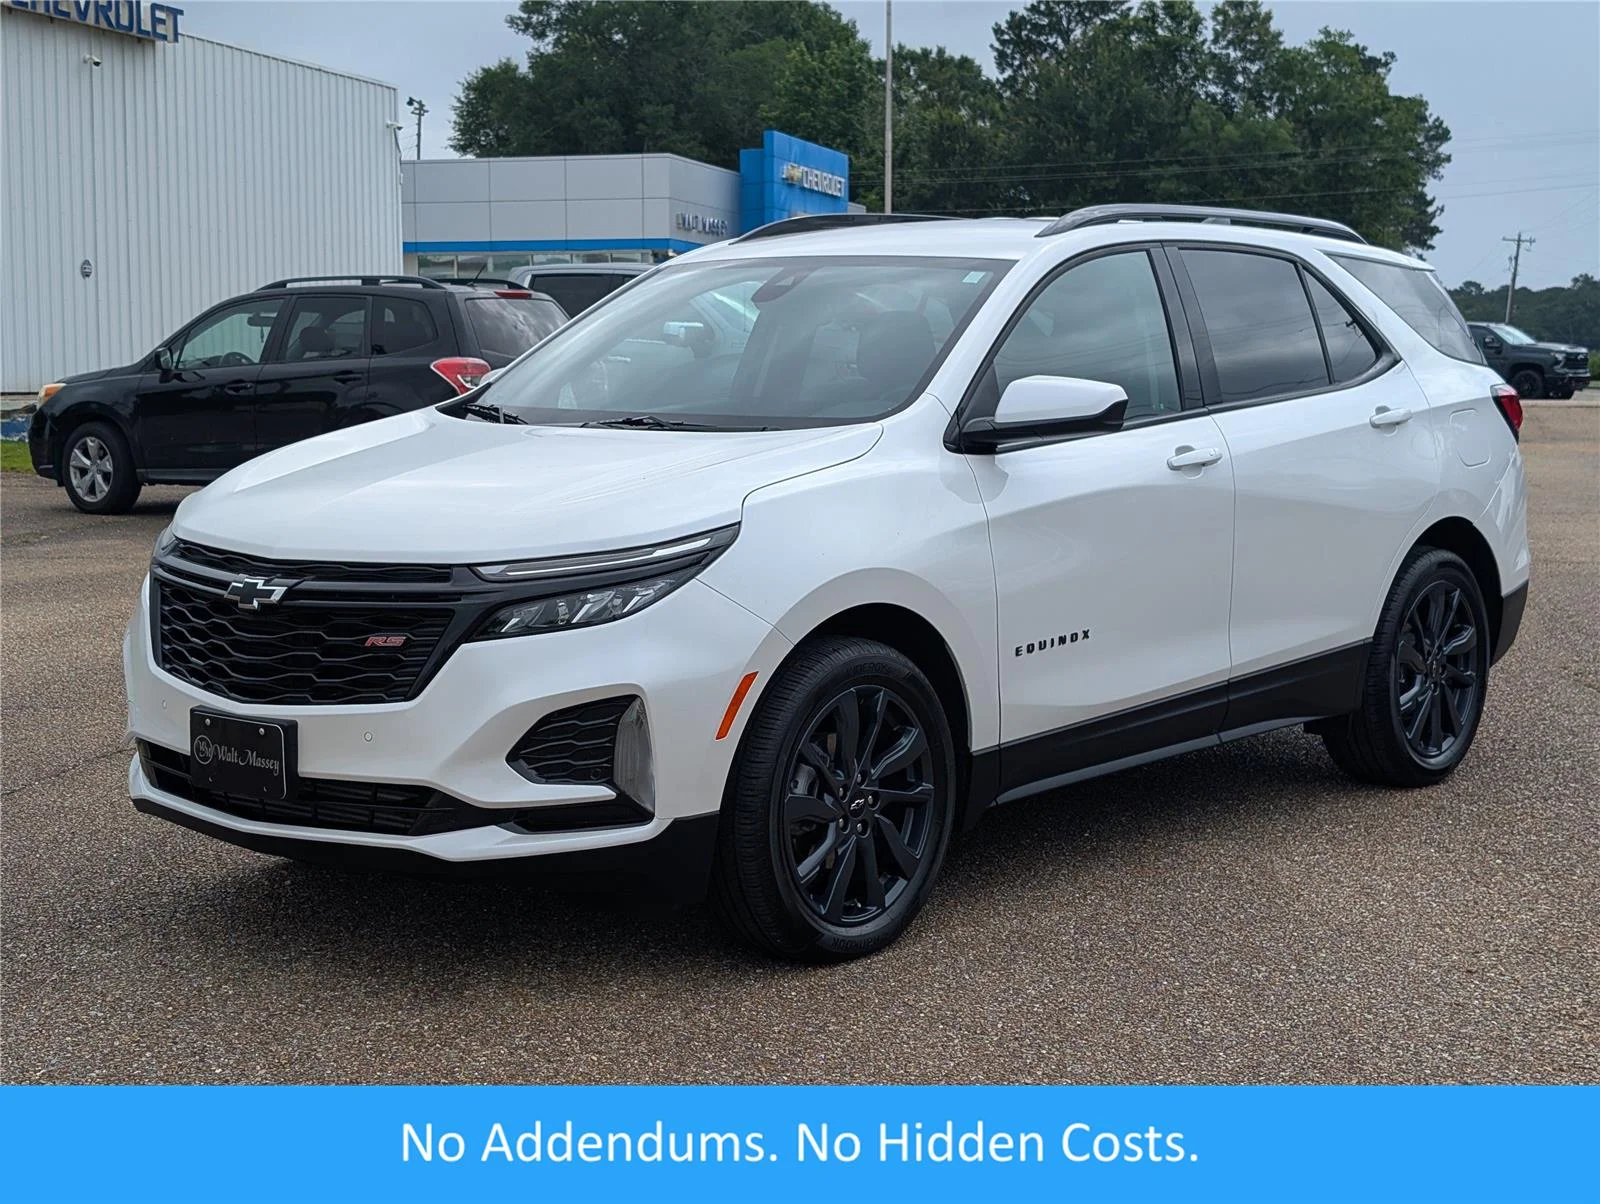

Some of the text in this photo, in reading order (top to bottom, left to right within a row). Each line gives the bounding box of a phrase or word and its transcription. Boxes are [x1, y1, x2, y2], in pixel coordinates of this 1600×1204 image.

[11, 0, 185, 43] VROLET
[801, 166, 846, 198] CHEVROLET
[364, 636, 406, 647] RS
[1015, 628, 1091, 657] EQUINOX
[212, 744, 239, 764] Walt
[239, 750, 280, 776] Massey
